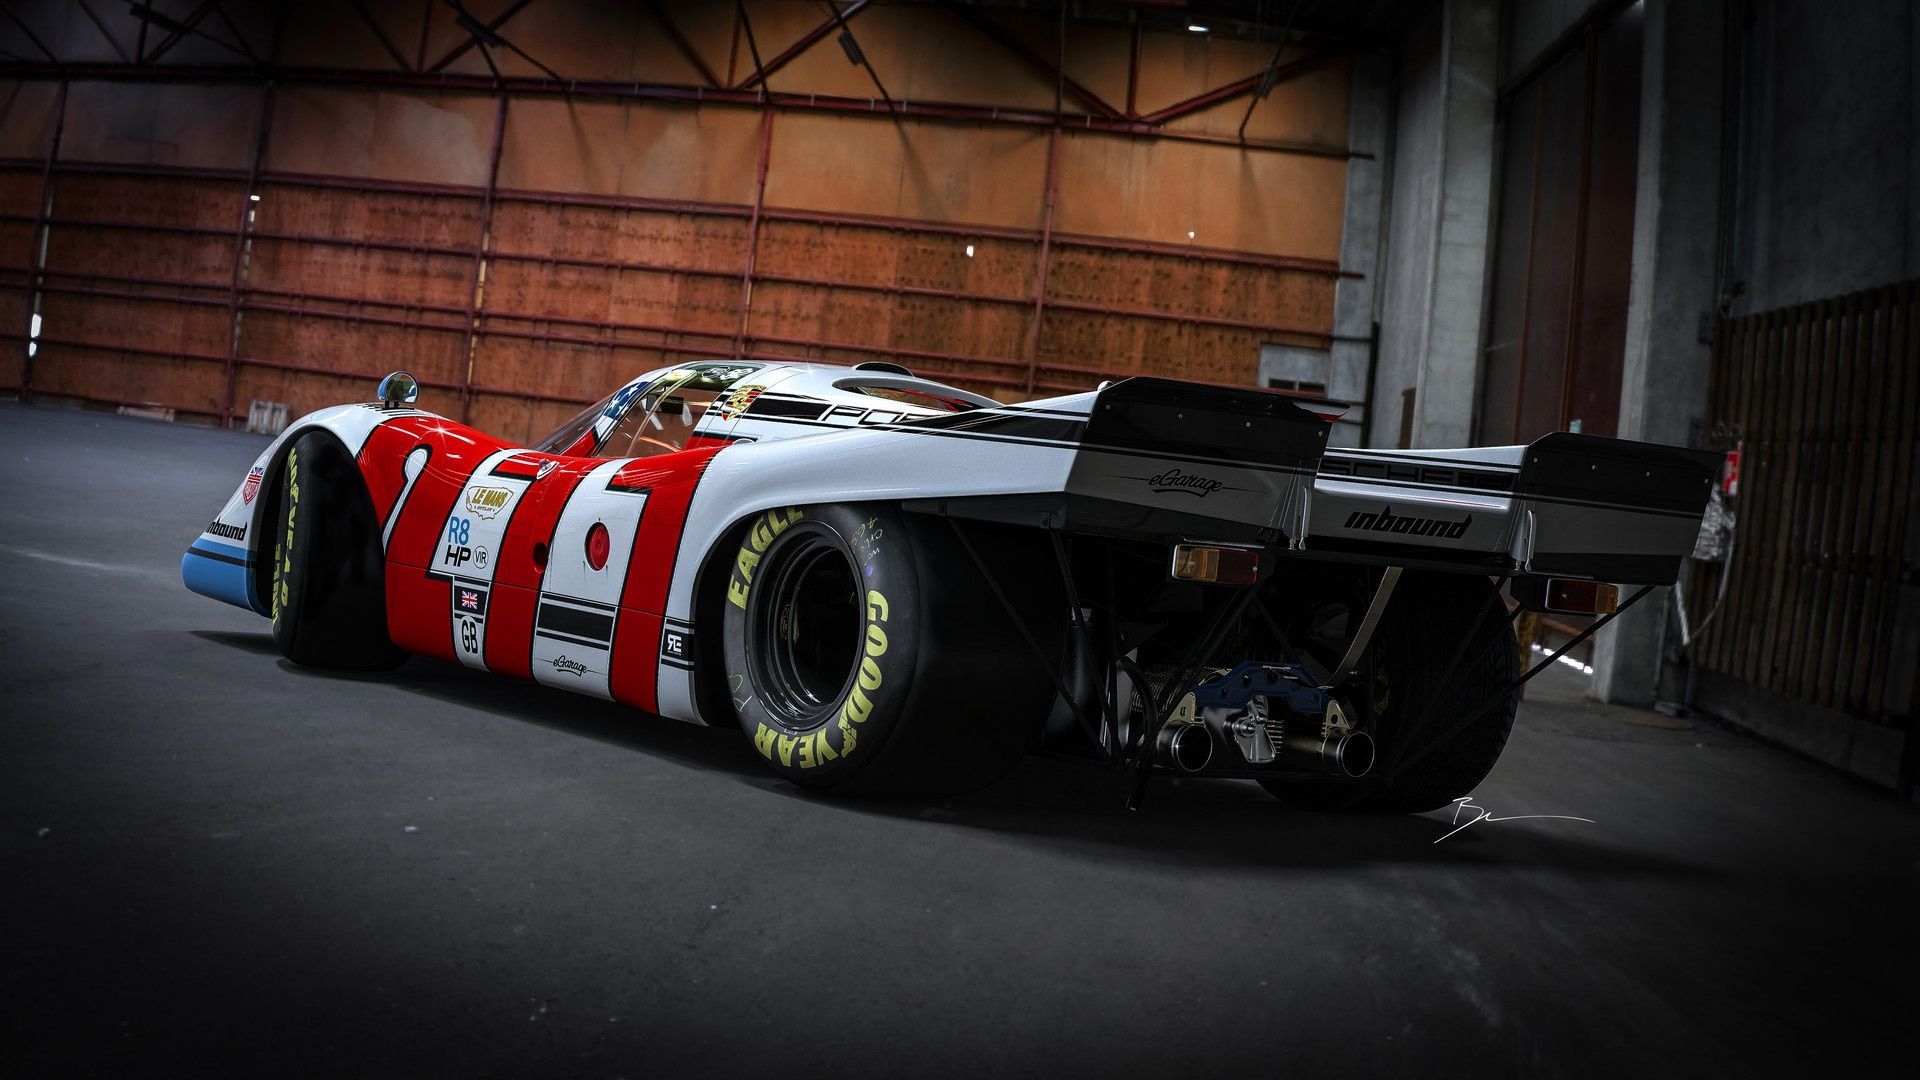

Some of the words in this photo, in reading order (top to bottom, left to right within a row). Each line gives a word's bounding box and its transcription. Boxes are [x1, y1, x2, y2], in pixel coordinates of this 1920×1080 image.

[1149, 469, 1222, 497] eGarage
[472, 489, 486, 504] LE
[482, 490, 508, 508] MANS
[448, 516, 470, 545] R8
[445, 544, 471, 567] HP
[461, 620, 478, 654] GB
[553, 655, 587, 677] eGarage
